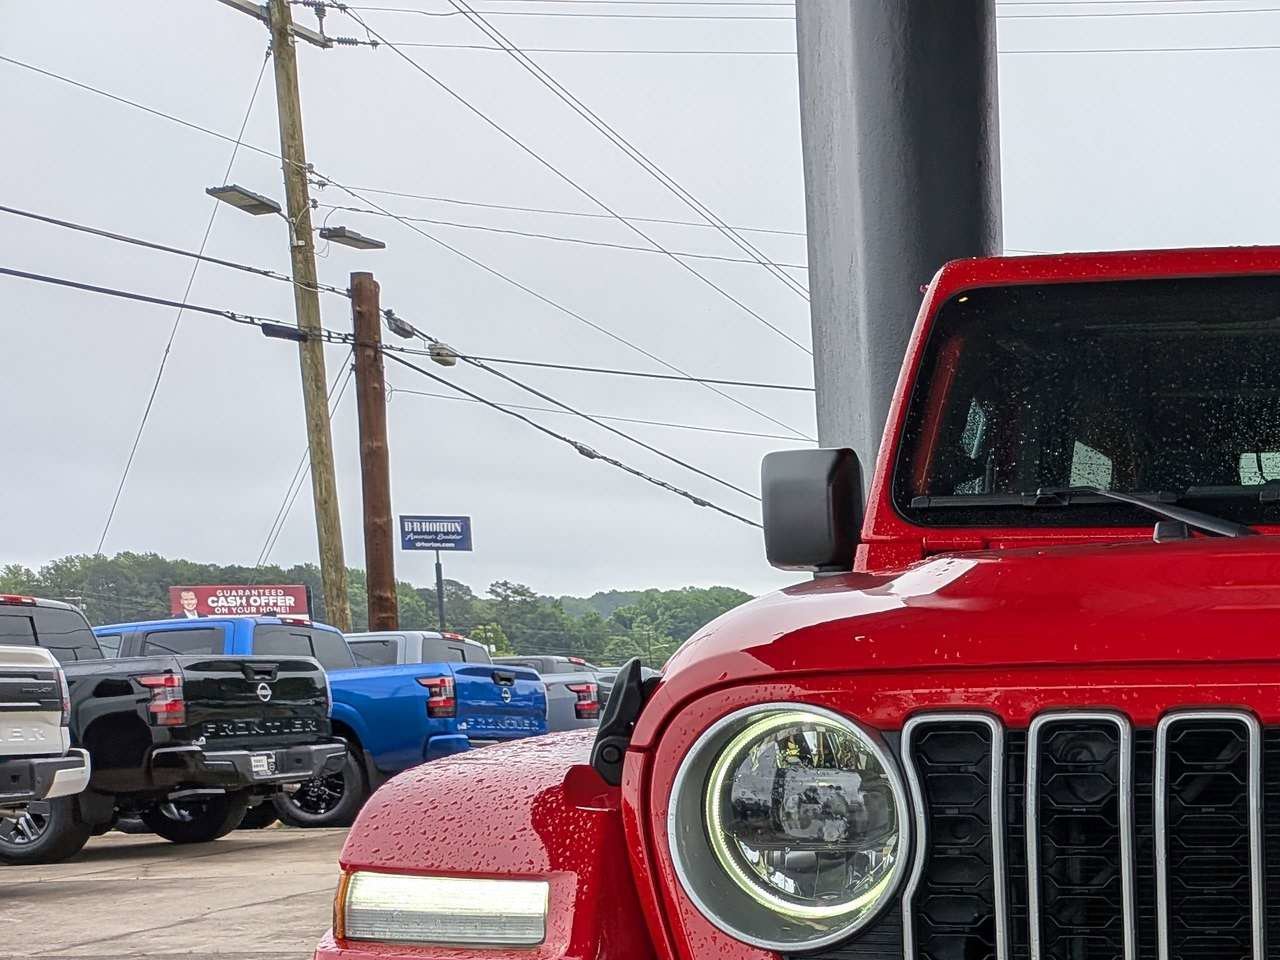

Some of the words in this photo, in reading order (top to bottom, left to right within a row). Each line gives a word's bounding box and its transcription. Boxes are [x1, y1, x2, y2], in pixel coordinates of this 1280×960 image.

[208, 596, 247, 607] CASH
[249, 596, 295, 607] OFFER
[215, 606, 229, 614] ON
[232, 606, 257, 614] YOUR
[204, 720, 317, 736] FRONTIER
[466, 717, 540, 730] FRONTIER
